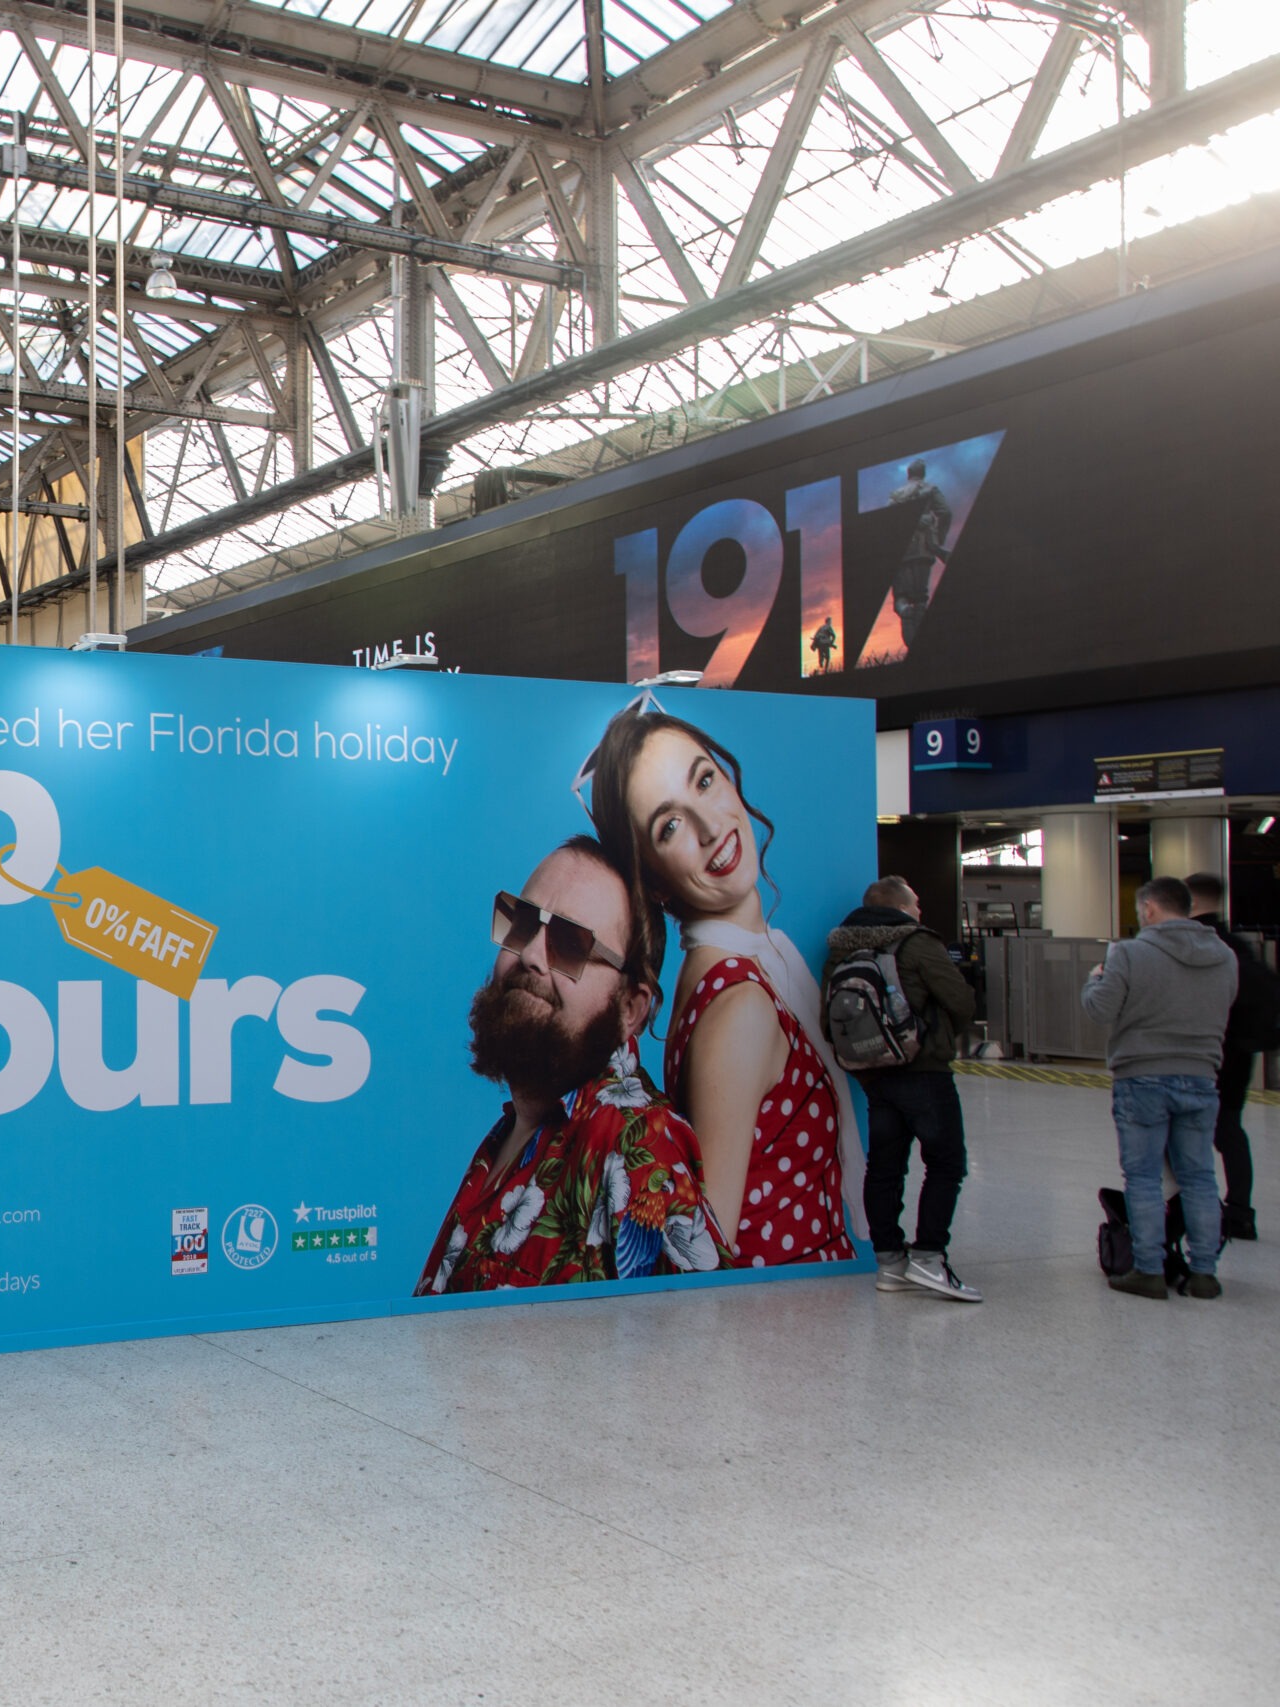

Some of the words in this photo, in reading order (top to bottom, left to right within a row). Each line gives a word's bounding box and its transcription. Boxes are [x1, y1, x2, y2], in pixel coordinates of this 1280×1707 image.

[614, 429, 1008, 689] 1917
[353, 639, 403, 669] TIME
[416, 632, 436, 656] IS
[57, 708, 133, 751] her
[150, 713, 299, 758] Florida
[315, 722, 459, 776] holiday
[927, 730, 943, 756] 9
[967, 728, 981, 754] 9
[84, 897, 130, 942] 0%
[127, 916, 195, 969] FAFF
[182, 1214, 198, 1222] FAST
[244, 1208, 264, 1217] 7227
[314, 1204, 378, 1222] Trustpilot
[179, 1223, 201, 1231] TRACK
[174, 1234, 206, 1253] 100
[225, 1241, 271, 1266] PROTECTED
[326, 1253, 341, 1264] 4.5
[342, 1252, 358, 1263] out
[359, 1250, 370, 1262] of
[370, 1250, 378, 1261] 5
